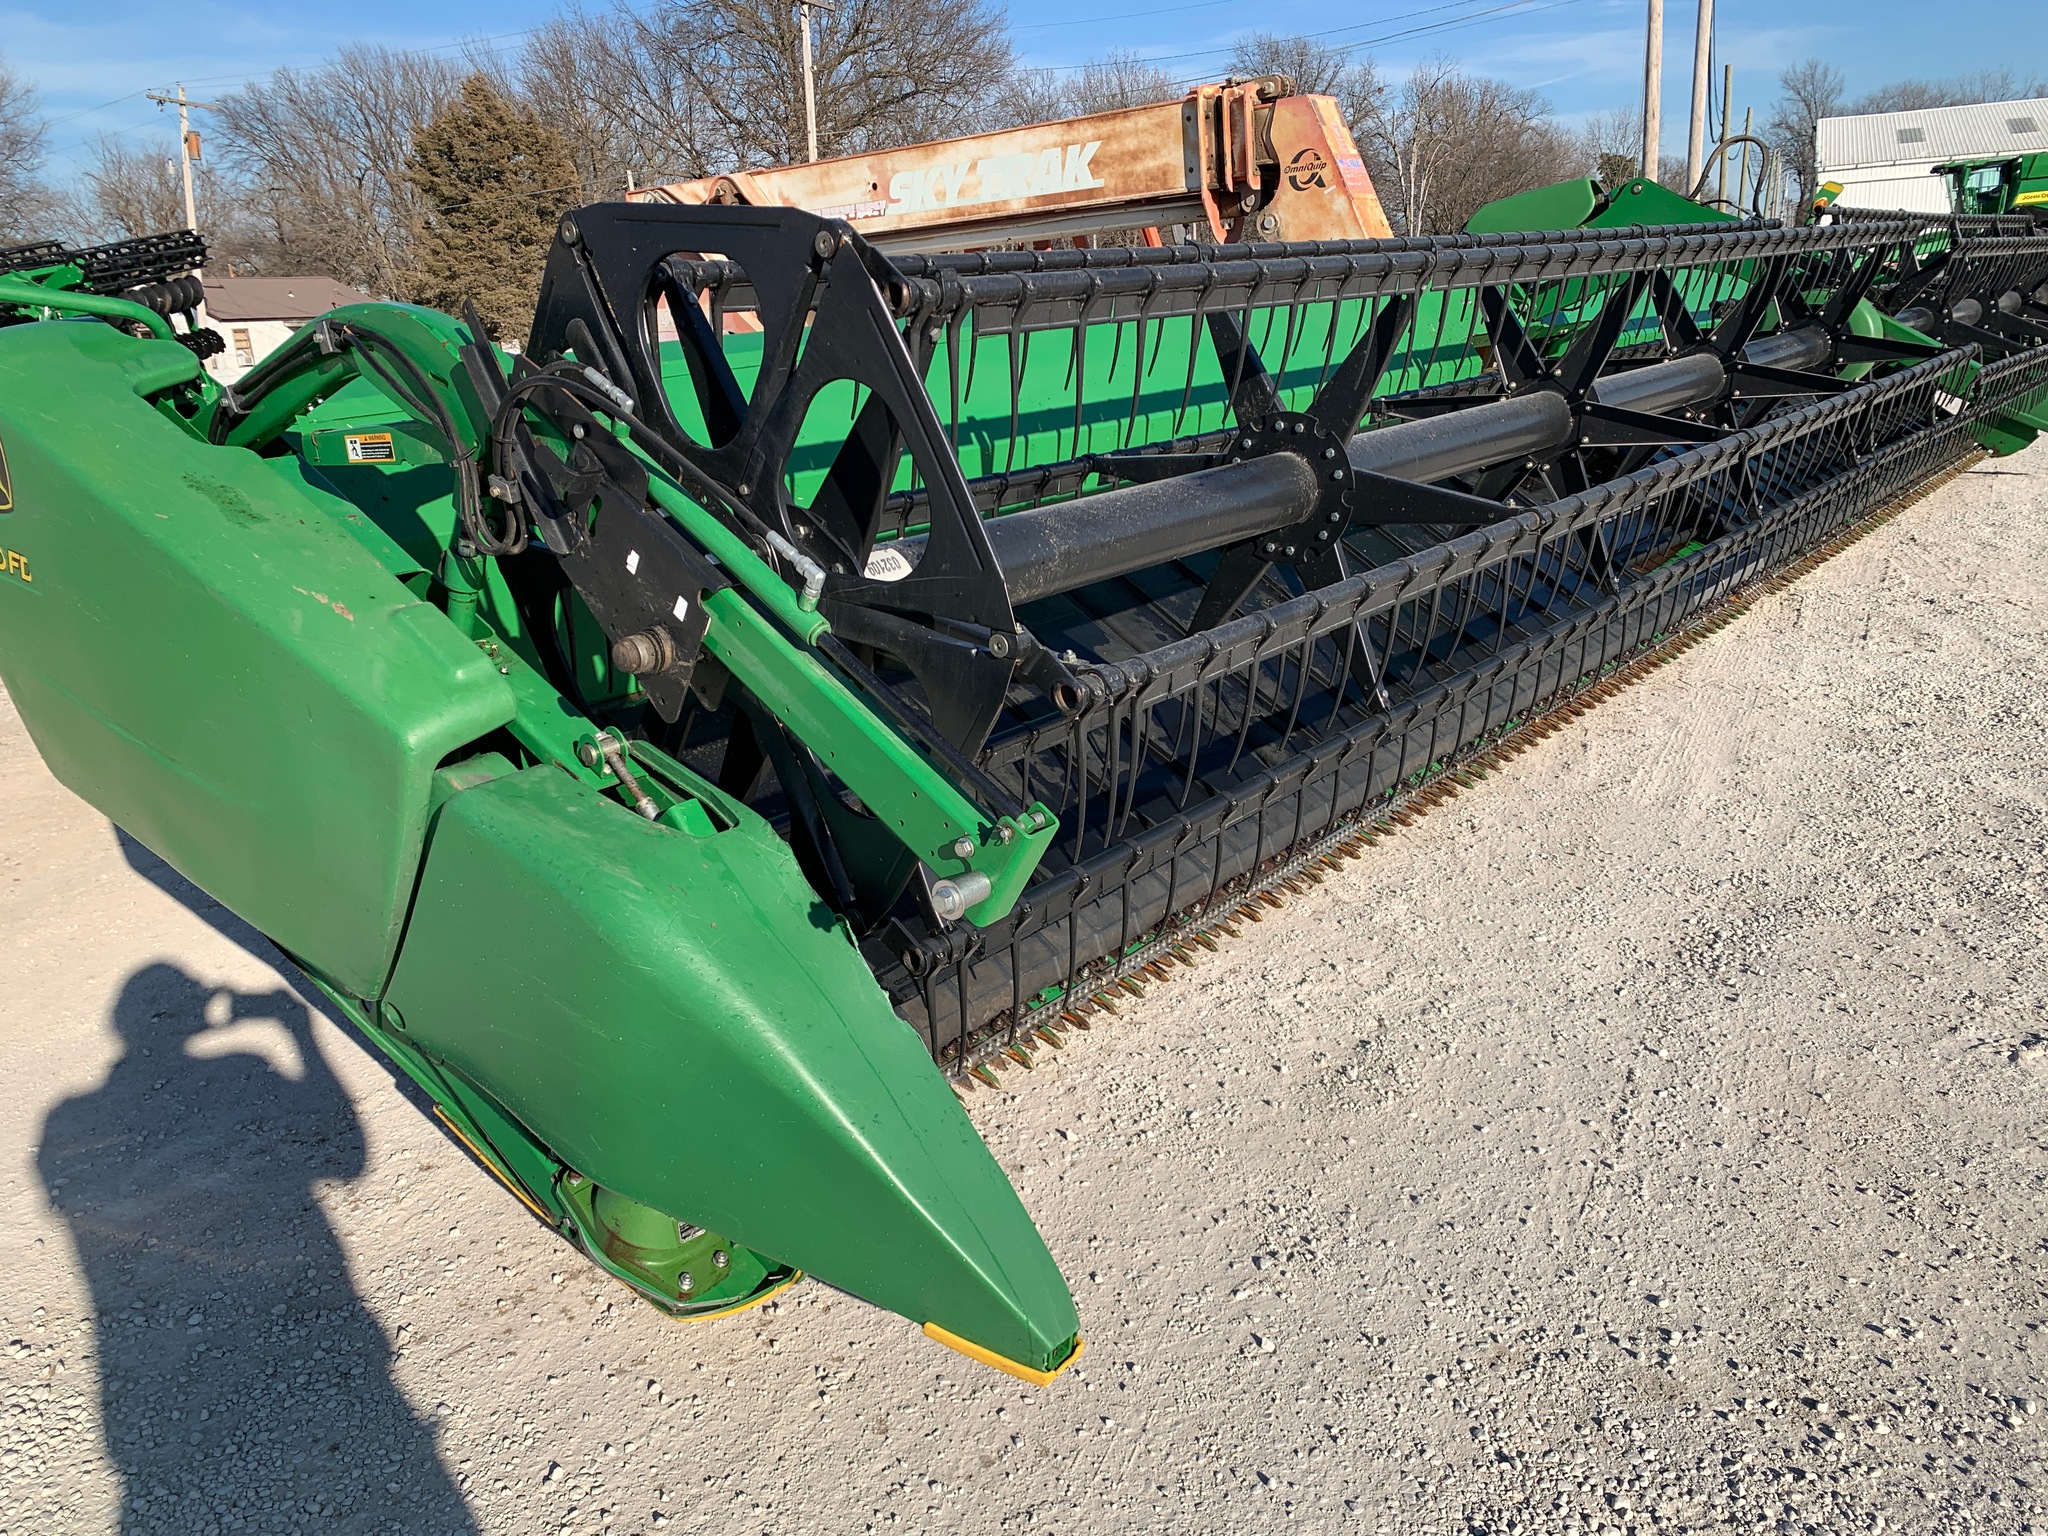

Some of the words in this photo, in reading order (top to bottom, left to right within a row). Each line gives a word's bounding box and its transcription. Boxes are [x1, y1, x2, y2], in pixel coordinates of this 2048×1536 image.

[887, 160, 972, 215] SKY
[975, 140, 1105, 204] TRAK
[1284, 161, 1327, 174] OmniQuip
